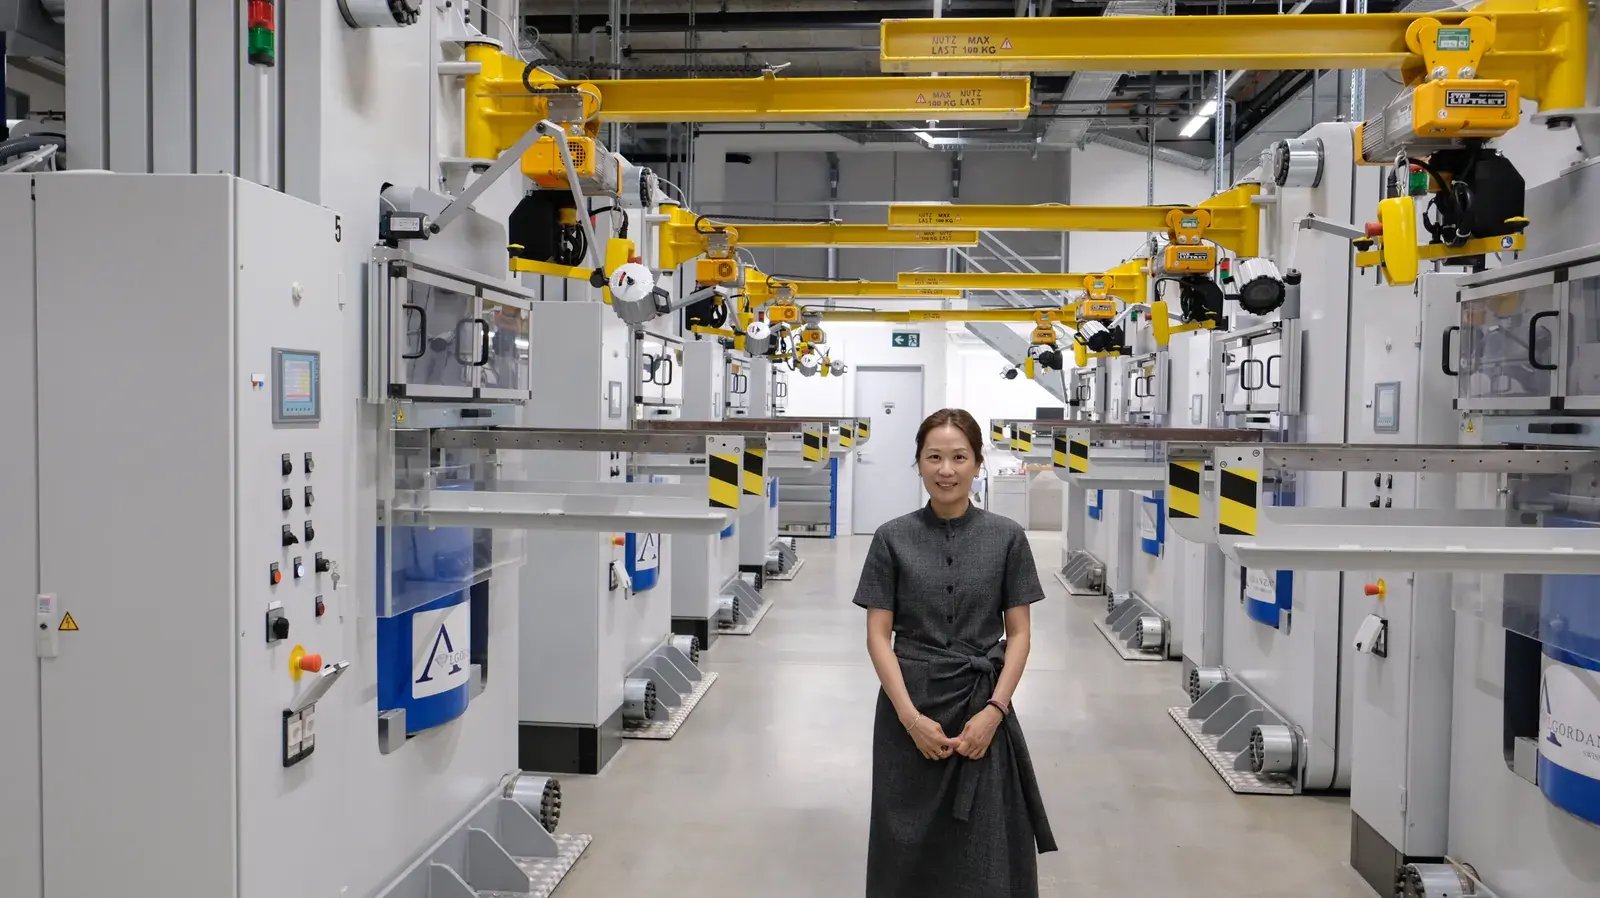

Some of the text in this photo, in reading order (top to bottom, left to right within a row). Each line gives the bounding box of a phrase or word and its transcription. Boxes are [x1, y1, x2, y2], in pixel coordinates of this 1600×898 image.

[932, 35, 990, 45] NUTZ MAX
[931, 46, 997, 55] LAST 100 KG
[932, 89, 982, 99] MAX NUTZ
[960, 98, 982, 106] LAST
[335, 214, 342, 243] 5
